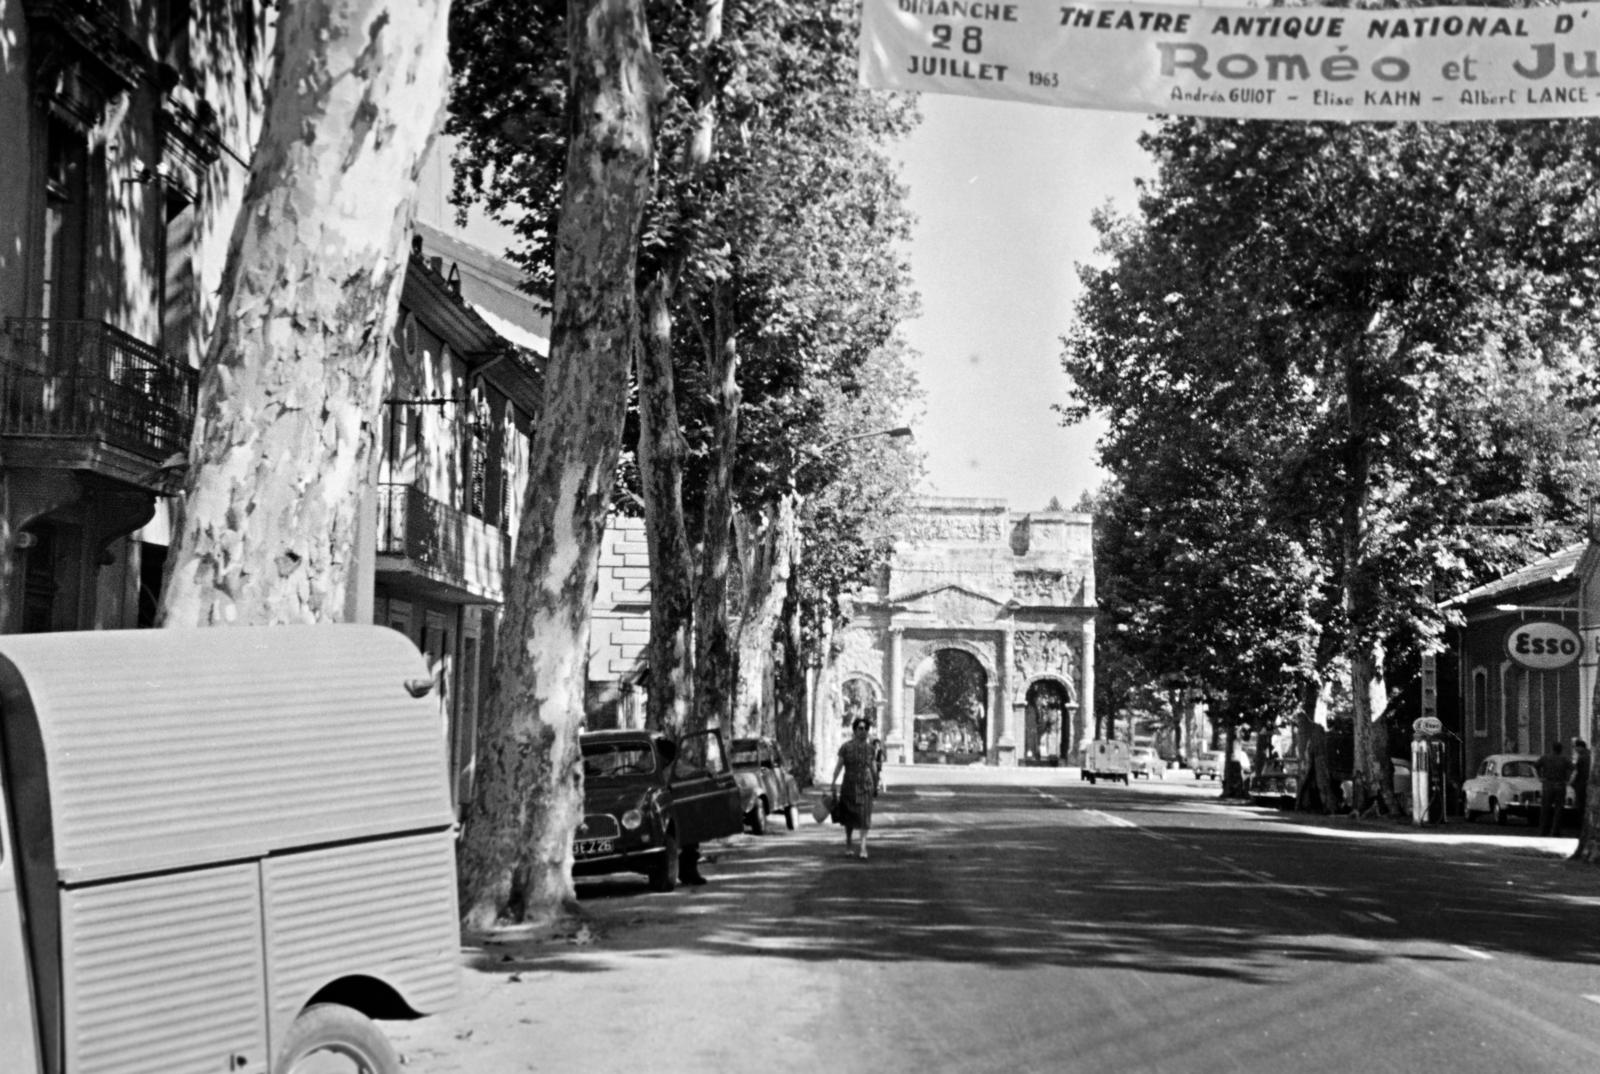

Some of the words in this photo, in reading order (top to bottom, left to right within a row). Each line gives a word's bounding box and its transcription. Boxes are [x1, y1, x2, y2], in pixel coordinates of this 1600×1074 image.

[898, 0, 1018, 22] DIMANCHE
[1060, 7, 1191, 33] THEATRE
[1211, 16, 1345, 39] ANTIQUE
[1367, 16, 1529, 38] NATIONAL
[931, 24, 982, 54] 28
[907, 55, 1009, 82] JUILLET
[1156, 42, 1411, 82] Roméo
[1441, 54, 1478, 81] et
[1028, 71, 1059, 88] 1963
[1229, 87, 1276, 104] GUIOT
[1313, 89, 1354, 106] Elise
[1364, 90, 1421, 106] KAHN
[1459, 89, 1516, 104] Albert
[1527, 87, 1589, 104] LANCE
